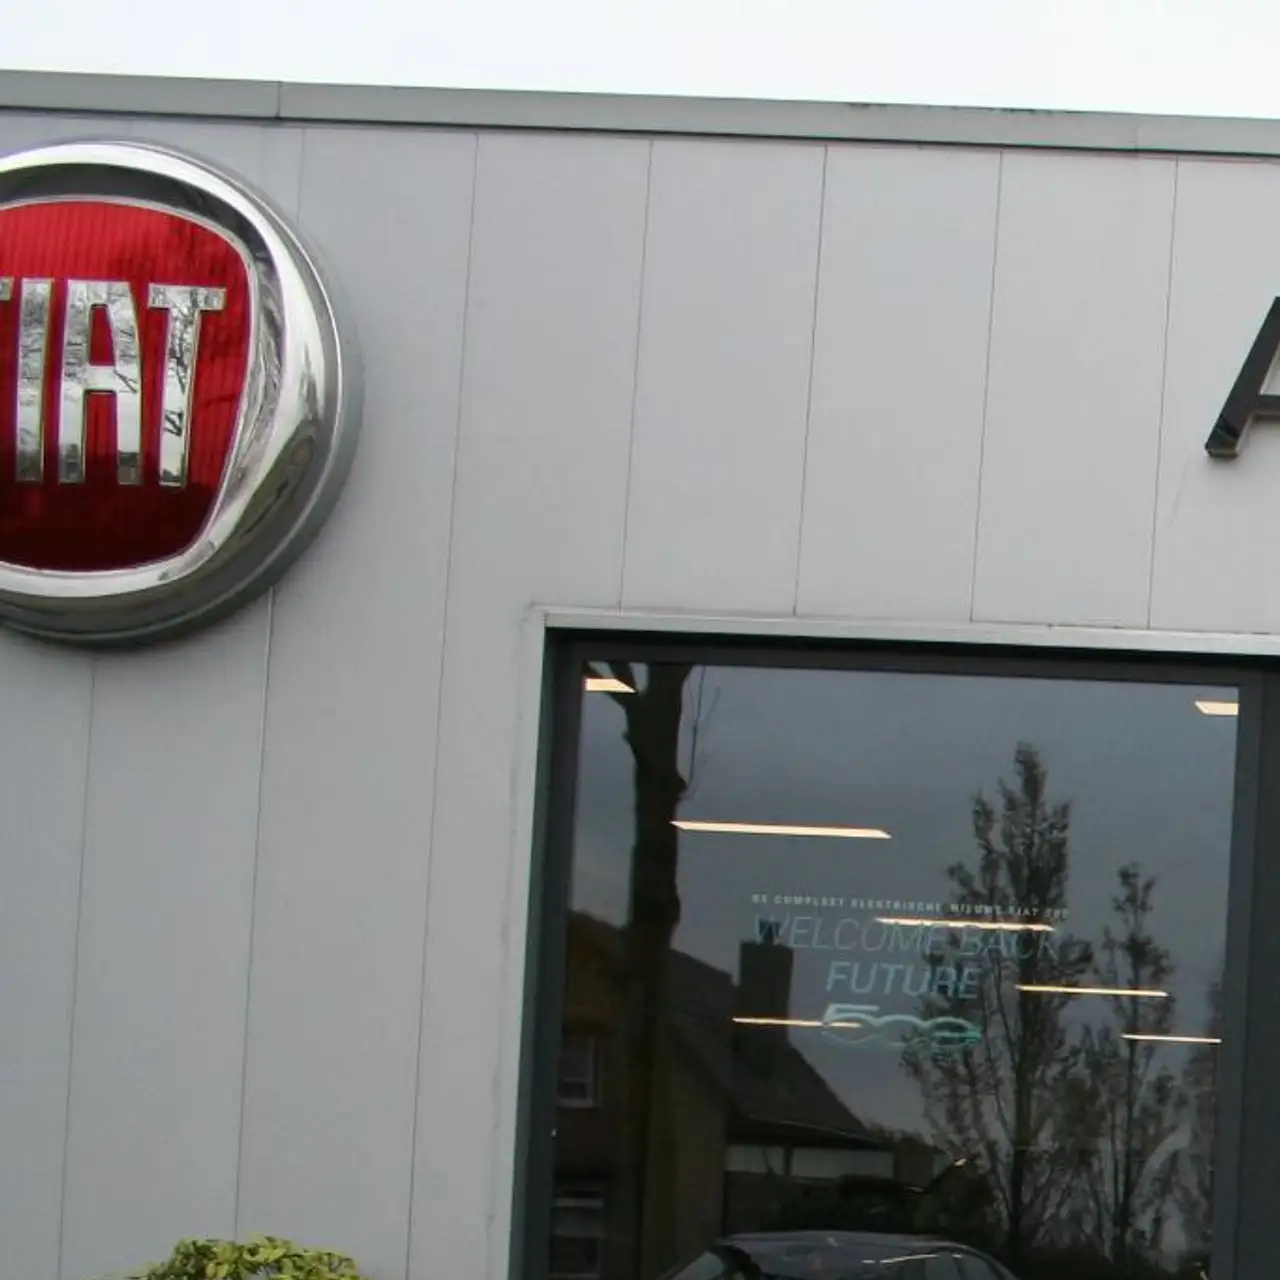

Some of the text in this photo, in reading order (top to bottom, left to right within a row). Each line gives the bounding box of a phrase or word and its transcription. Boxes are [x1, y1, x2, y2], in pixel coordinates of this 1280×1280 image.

[0, 276, 227, 489] IAT
[754, 912, 944, 953] WELCOME
[826, 960, 983, 999] FUTURE
